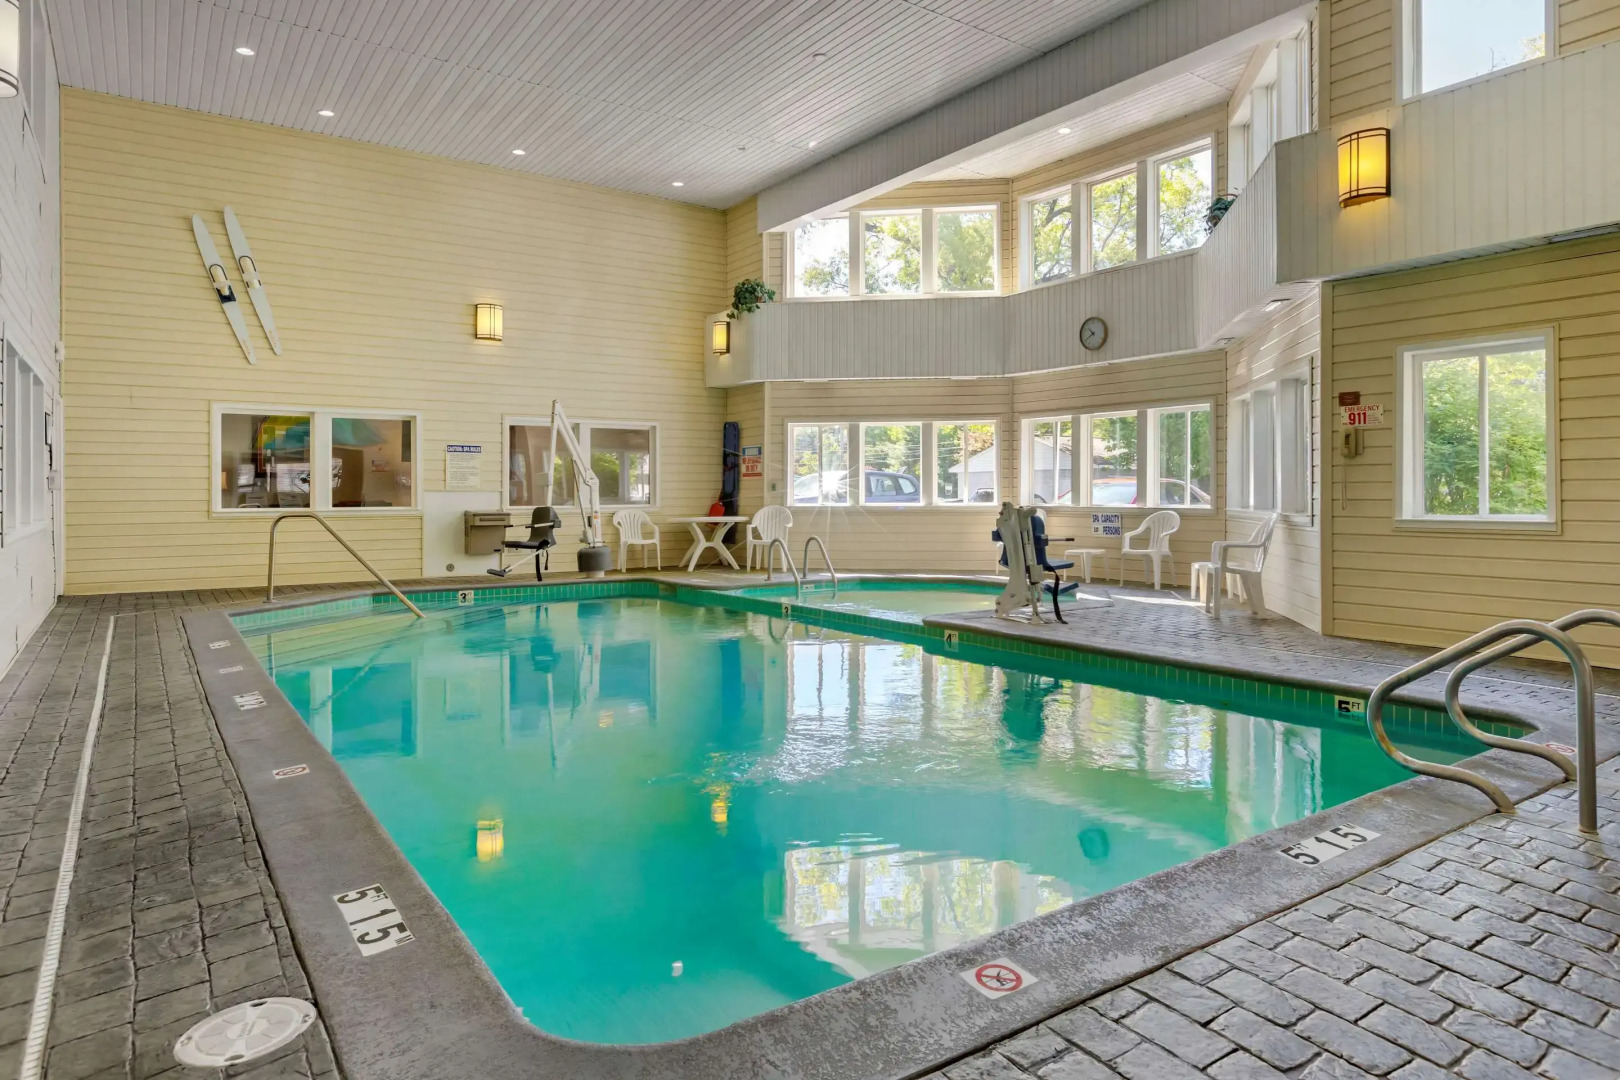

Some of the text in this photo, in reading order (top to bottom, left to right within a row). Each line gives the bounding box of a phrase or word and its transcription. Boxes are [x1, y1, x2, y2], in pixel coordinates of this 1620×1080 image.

[1345, 405, 1380, 413] EMERGENCY
[1348, 412, 1367, 425] 911
[1101, 514, 1120, 524] CAPACITY
[1103, 526, 1120, 535] PERSONS
[1338, 699, 1360, 712] 5 FT
[1280, 846, 1320, 865] 5
[336, 885, 384, 904] 5
